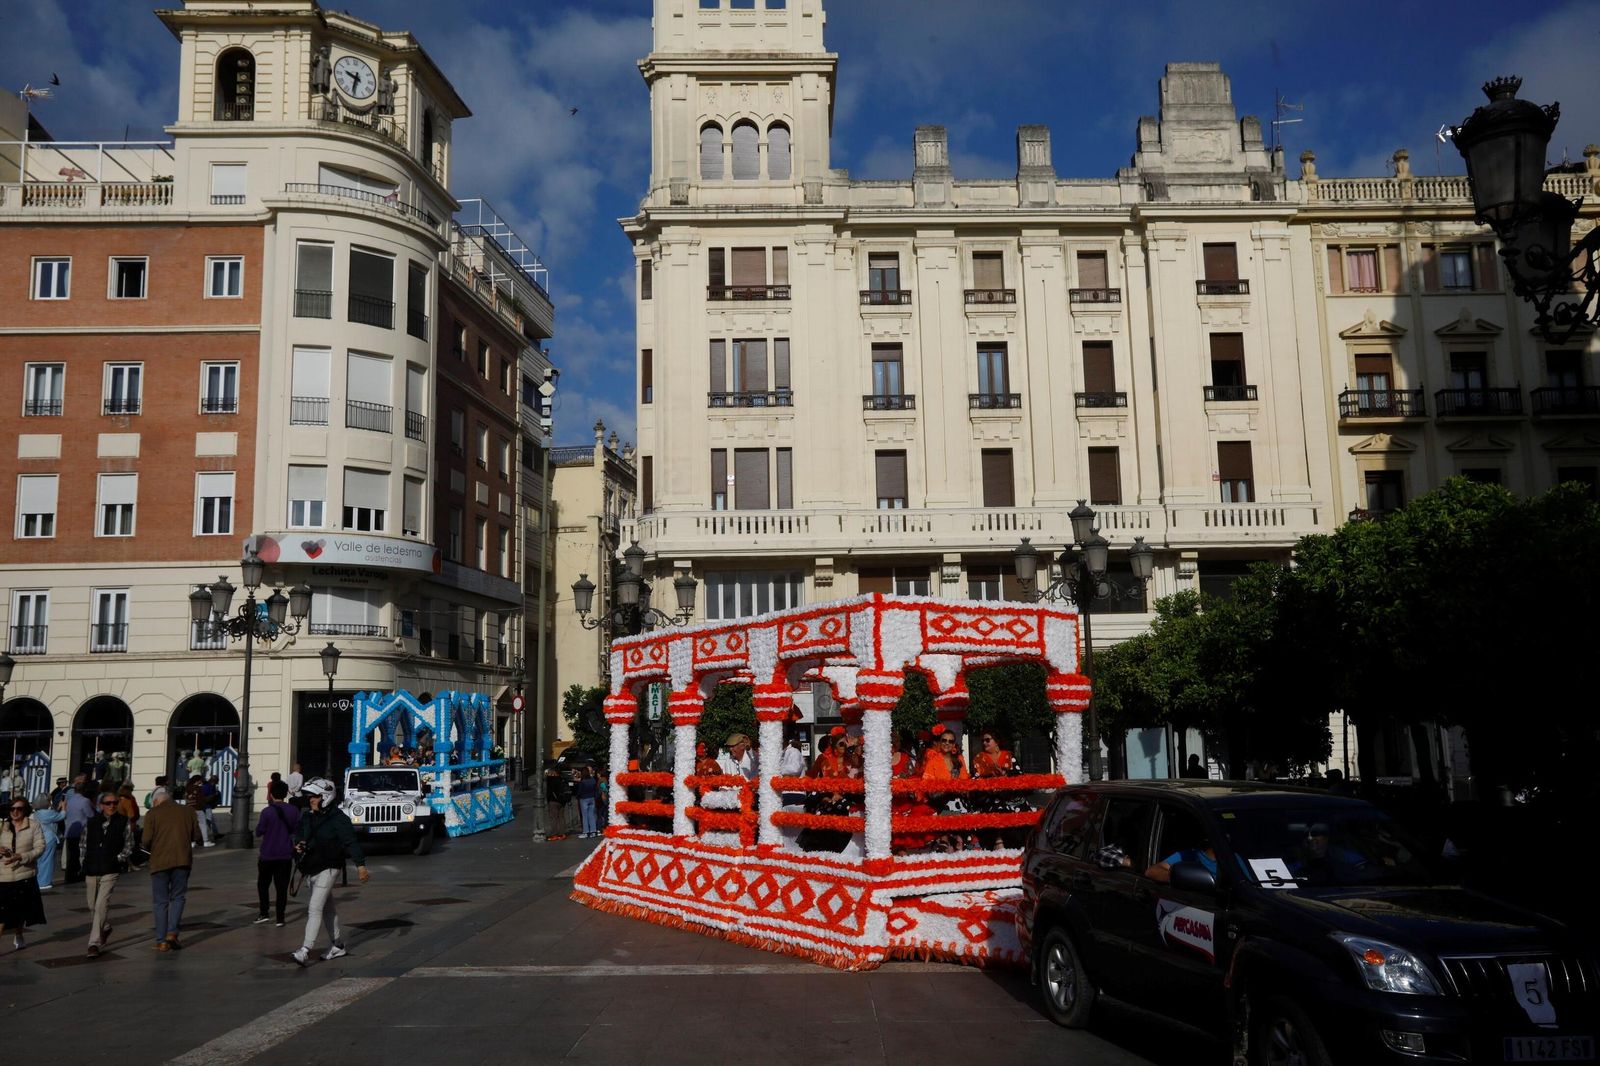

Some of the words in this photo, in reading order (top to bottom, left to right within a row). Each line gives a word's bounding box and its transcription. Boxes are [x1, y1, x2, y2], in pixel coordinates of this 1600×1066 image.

[334, 541, 363, 552] Valle
[366, 543, 381, 553] de
[383, 543, 423, 558] ledesma
[1264, 869, 1284, 887] 5
[1525, 978, 1543, 1005] 5
[1517, 1040, 1556, 1058] 1142
